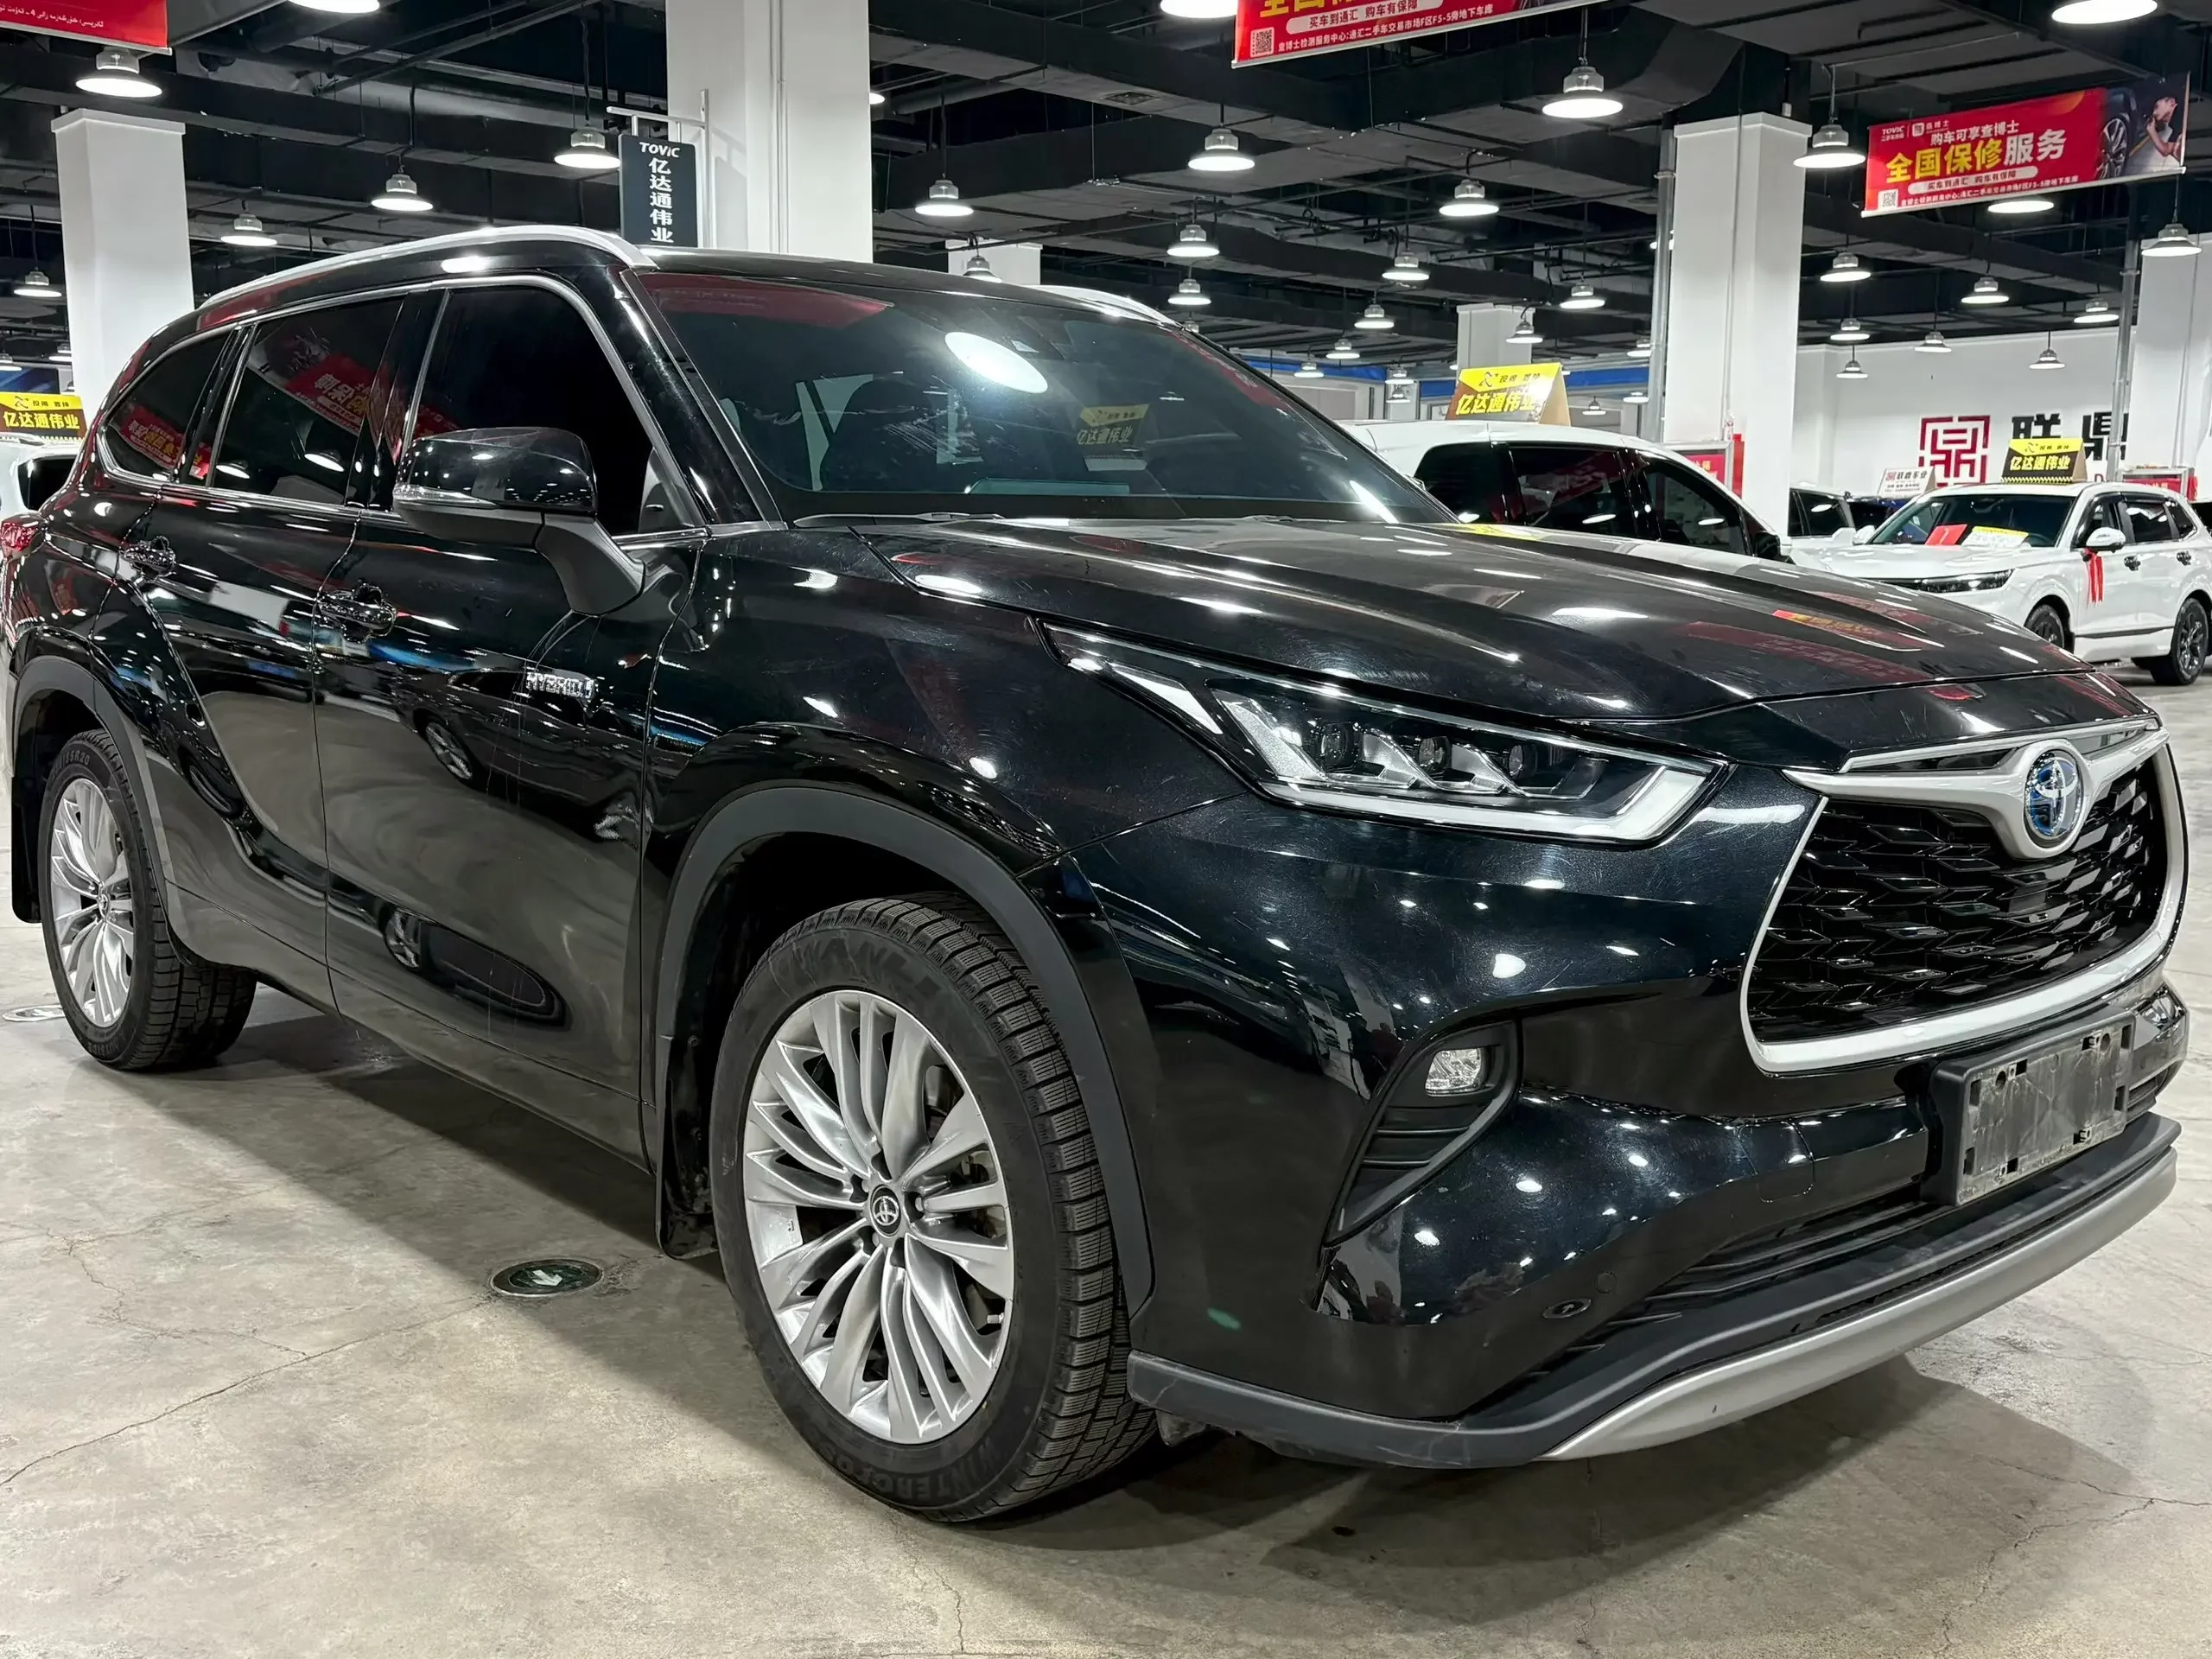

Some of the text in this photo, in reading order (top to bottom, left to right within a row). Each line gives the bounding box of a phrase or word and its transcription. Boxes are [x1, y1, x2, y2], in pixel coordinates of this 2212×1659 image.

[1309, 9, 1358, 29] 买车到通汇
[1365, 0, 1418, 17] 购车有保障
[1881, 125, 1905, 135] TOVIC
[1930, 119, 2019, 146] 购车可享查博士
[639, 142, 681, 158] TOVIC
[1885, 129, 2067, 183] 全国保修服务
[648, 157, 675, 244] 亿达通伟业
[1455, 391, 1537, 416] 亿达通伟业
[3, 411, 80, 429] 亿达通伟业
[2010, 454, 2071, 471] 亿达通伟业
